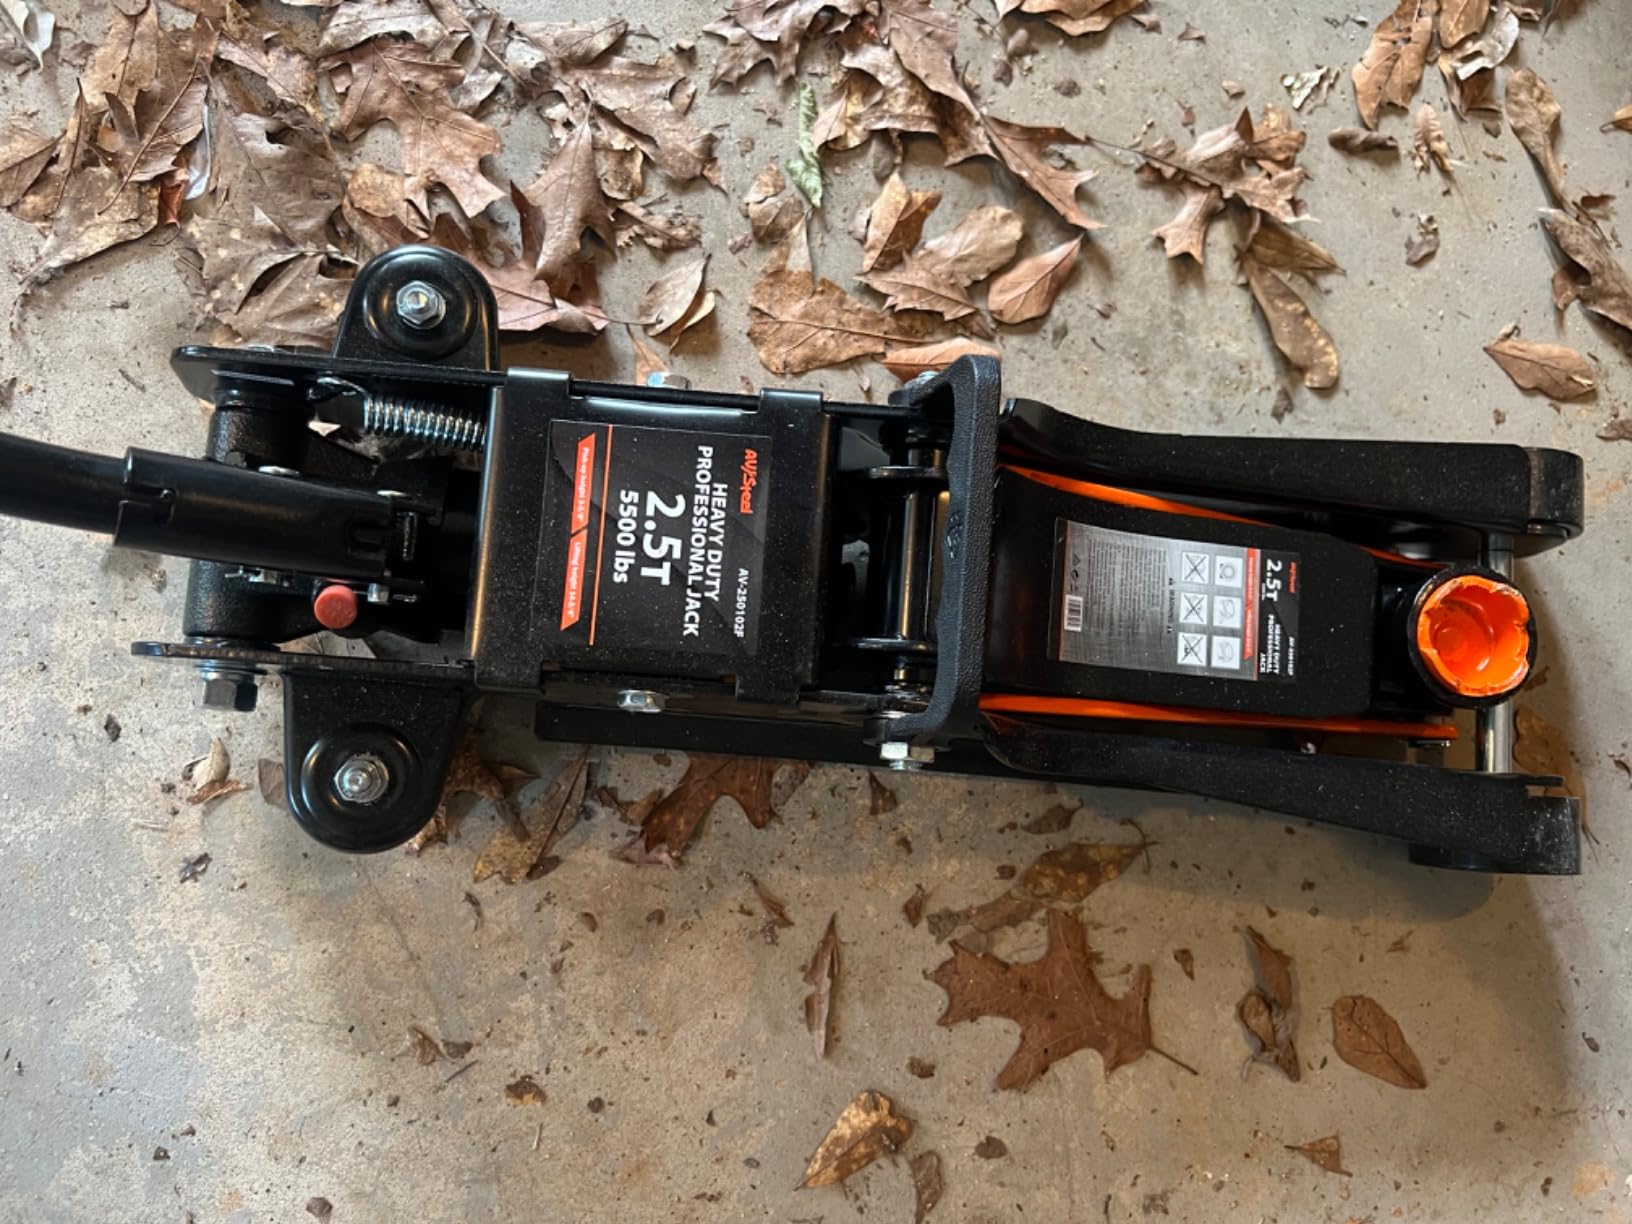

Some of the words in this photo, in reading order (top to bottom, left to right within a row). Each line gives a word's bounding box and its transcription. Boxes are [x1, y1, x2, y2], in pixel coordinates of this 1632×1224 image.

[578, 475, 588, 498] height
[616, 489, 639, 547] 5500
[640, 490, 687, 586] 2.5T
[687, 445, 714, 586] PROFESSIONAL
[708, 483, 728, 546] HEAVY
[569, 567, 579, 589] height
[571, 541, 581, 566] Lifting
[613, 550, 636, 584] lbs
[704, 549, 723, 602] DUTY
[733, 568, 749, 638] AV-250102F
[1266, 558, 1282, 601] 2.5T
[683, 587, 702, 637] JACK
[1266, 614, 1275, 673] PROFESSIONAL
[1272, 652, 1280, 674] DUTY
